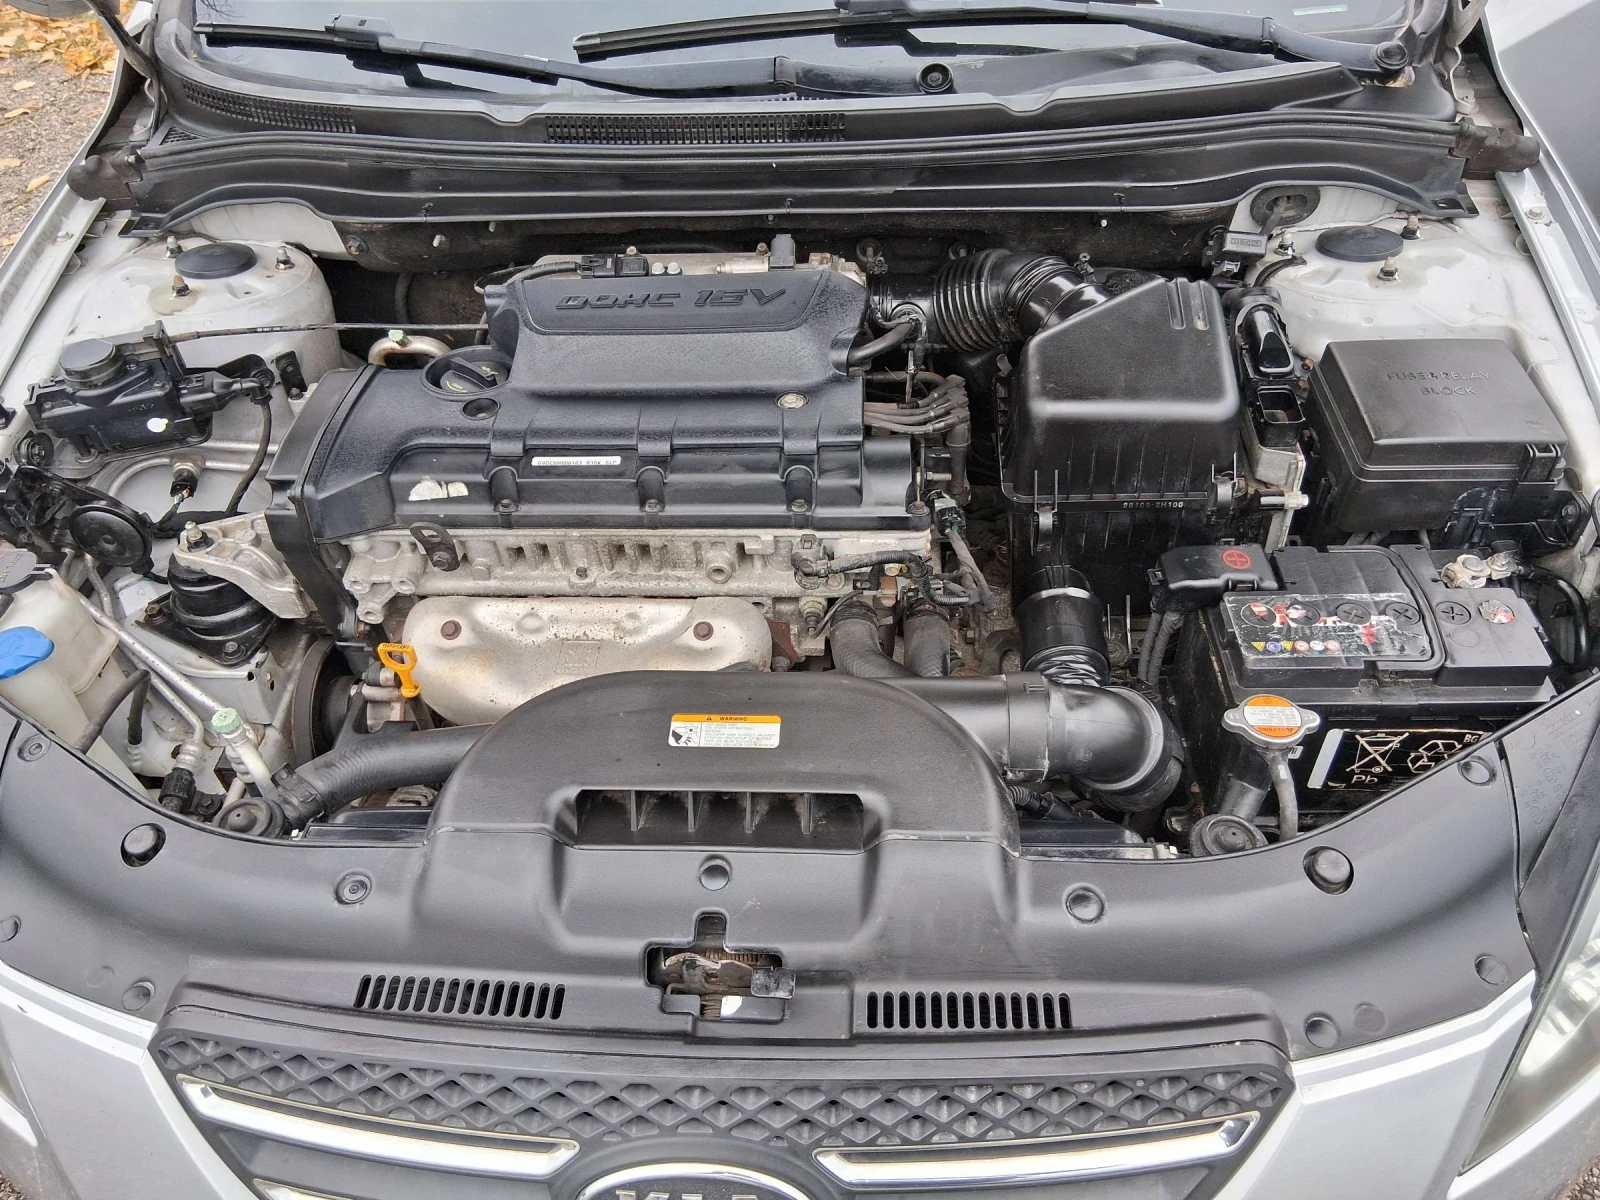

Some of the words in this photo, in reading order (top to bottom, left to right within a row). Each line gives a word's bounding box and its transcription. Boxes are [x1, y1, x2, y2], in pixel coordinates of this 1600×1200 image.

[556, 292, 681, 310] DOHC
[694, 288, 787, 307] 16V
[1420, 386, 1477, 396] BLOCK
[1463, 733, 1480, 744] BG
[1351, 774, 1379, 785] Pb
